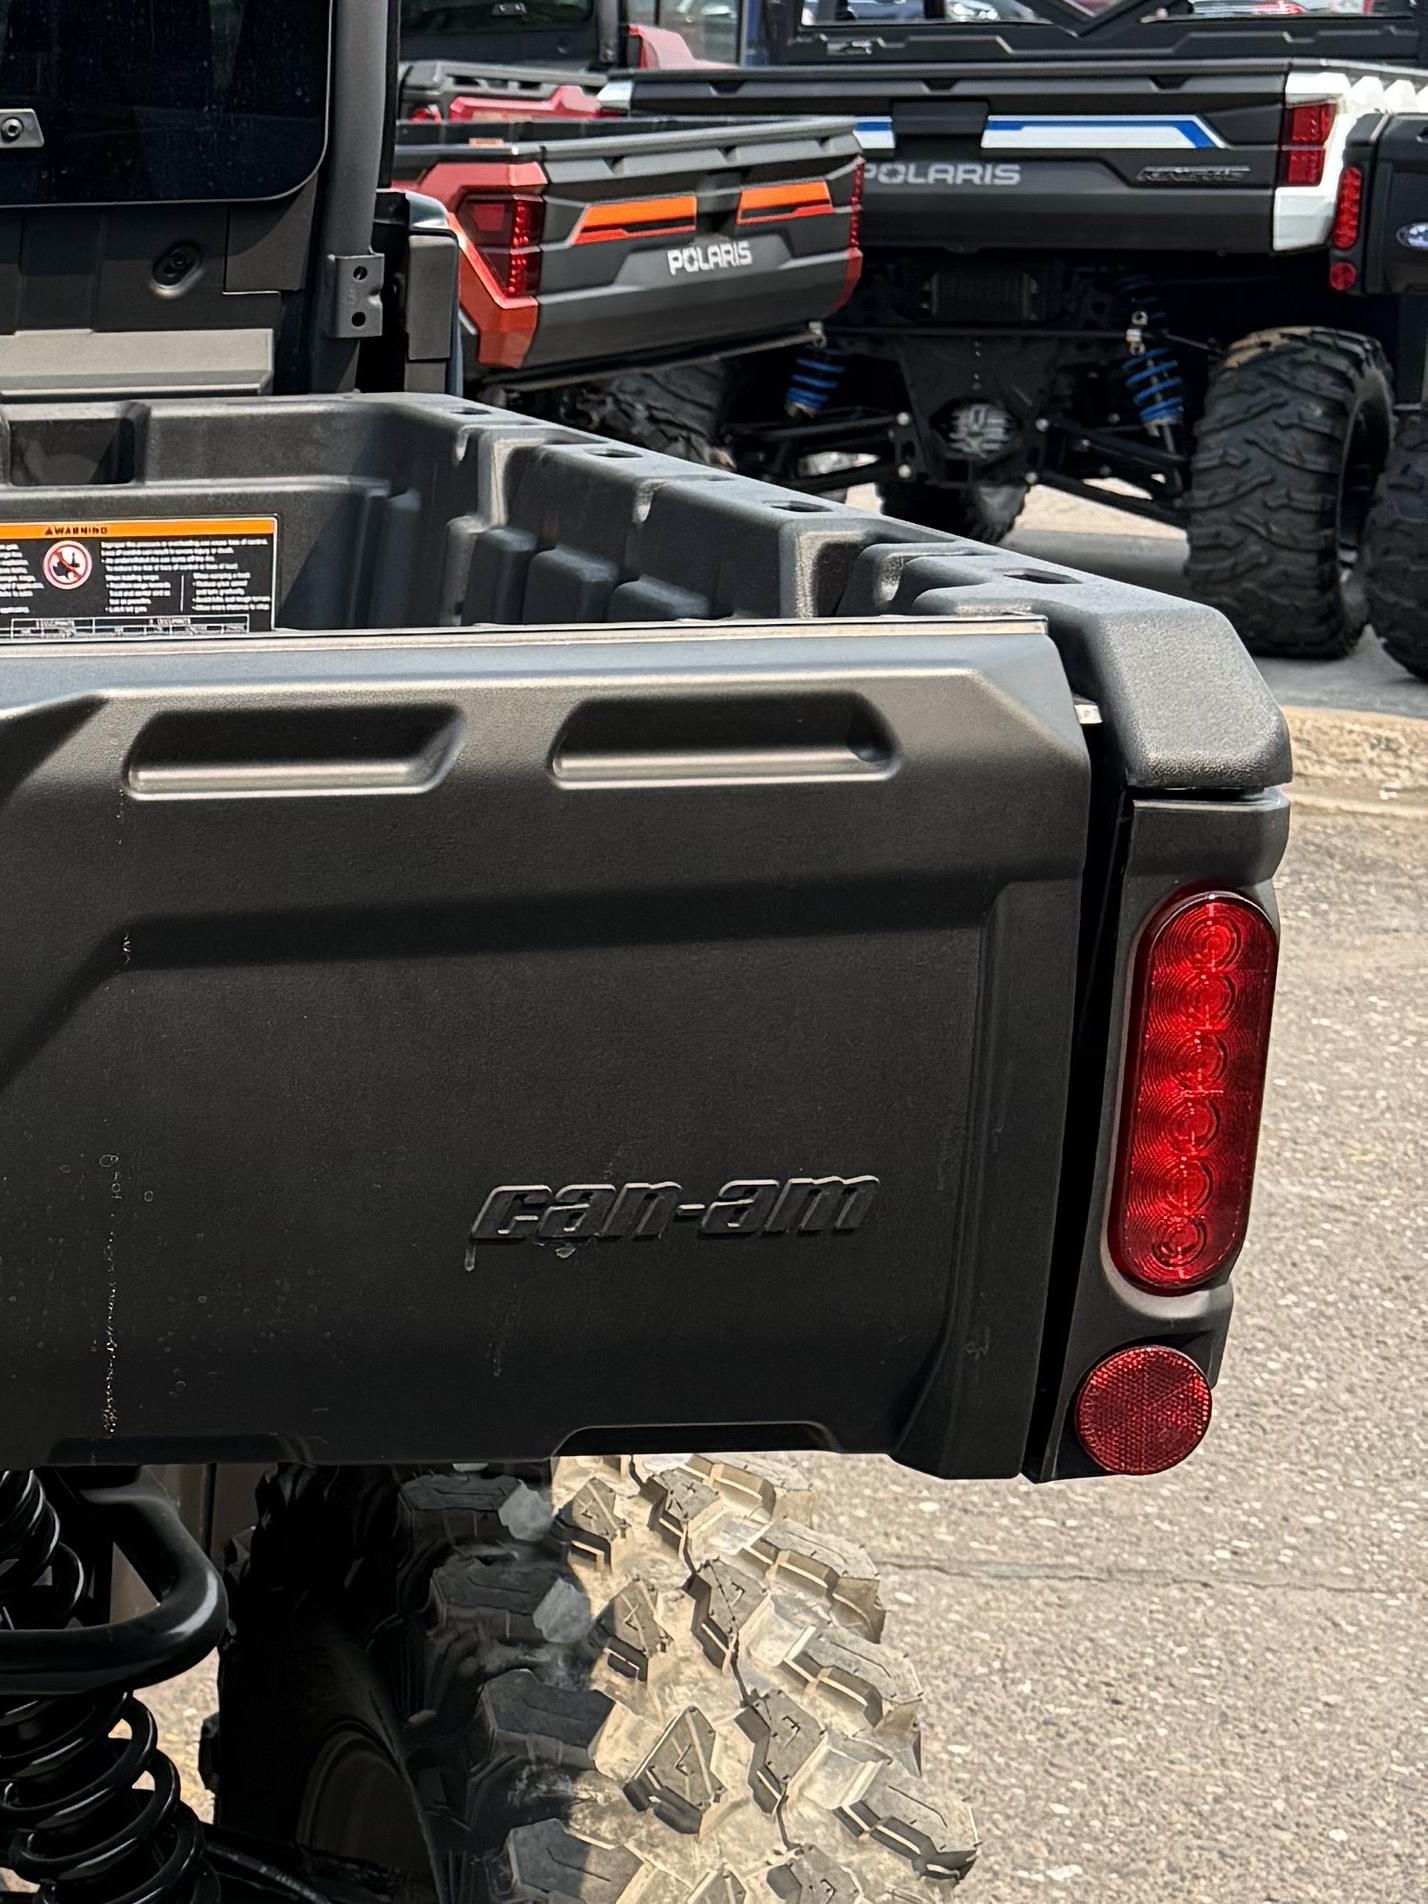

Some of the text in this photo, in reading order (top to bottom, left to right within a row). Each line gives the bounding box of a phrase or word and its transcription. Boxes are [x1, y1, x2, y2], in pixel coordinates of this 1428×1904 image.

[864, 163, 1022, 185] POLARIS
[667, 240, 753, 276] POLARIS
[470, 1175, 881, 1242] can-am
